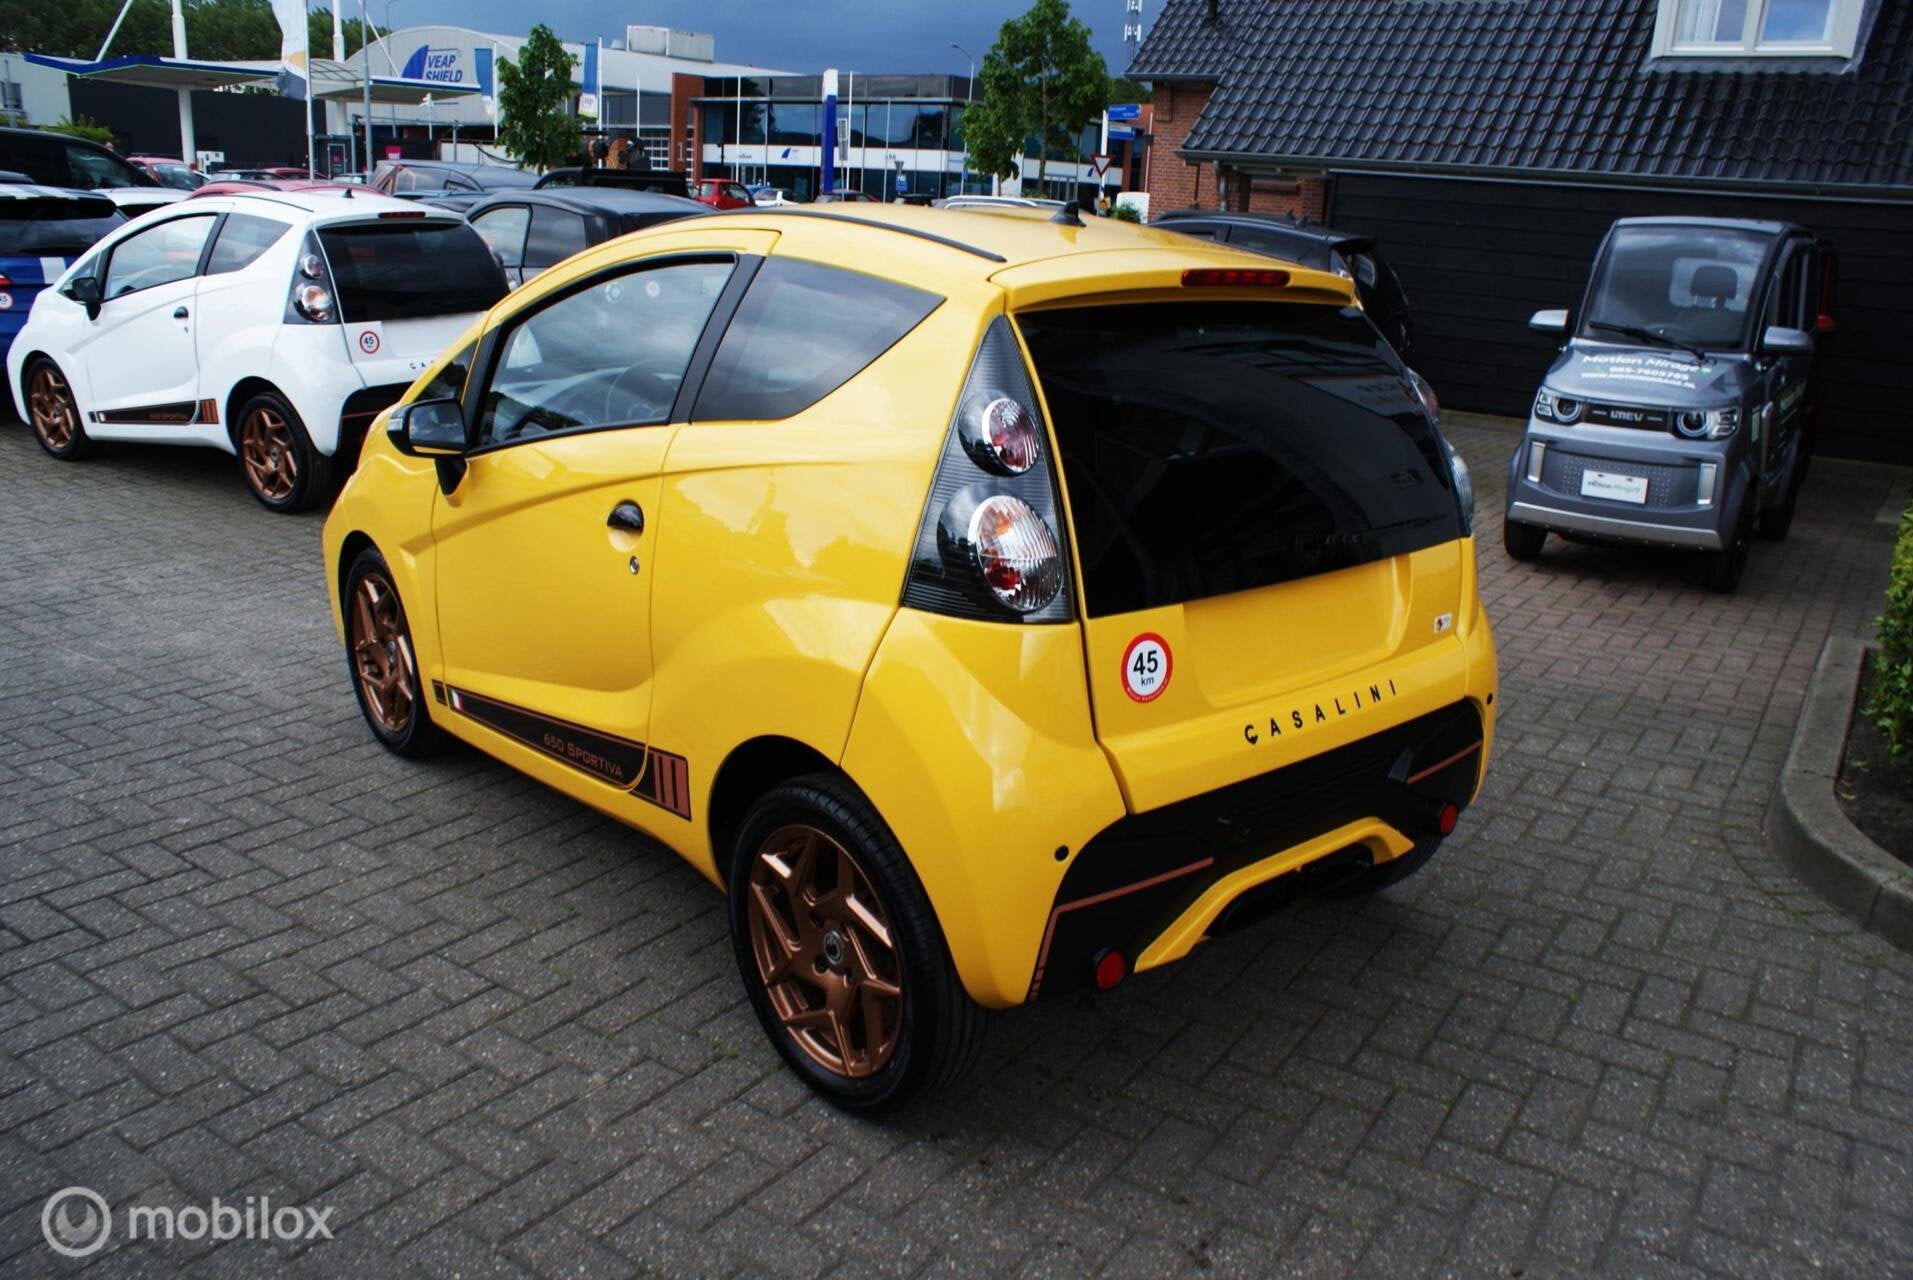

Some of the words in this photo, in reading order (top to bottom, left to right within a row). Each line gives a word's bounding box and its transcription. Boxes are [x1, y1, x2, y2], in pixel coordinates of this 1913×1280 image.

[428, 54, 457, 68] VEAP
[425, 70, 463, 83] SHIELD
[363, 336, 375, 345] 45
[1133, 650, 1159, 675] 45
[1140, 676, 1155, 686] km
[1244, 679, 1397, 745] CASALINI
[543, 733, 564, 753] 650
